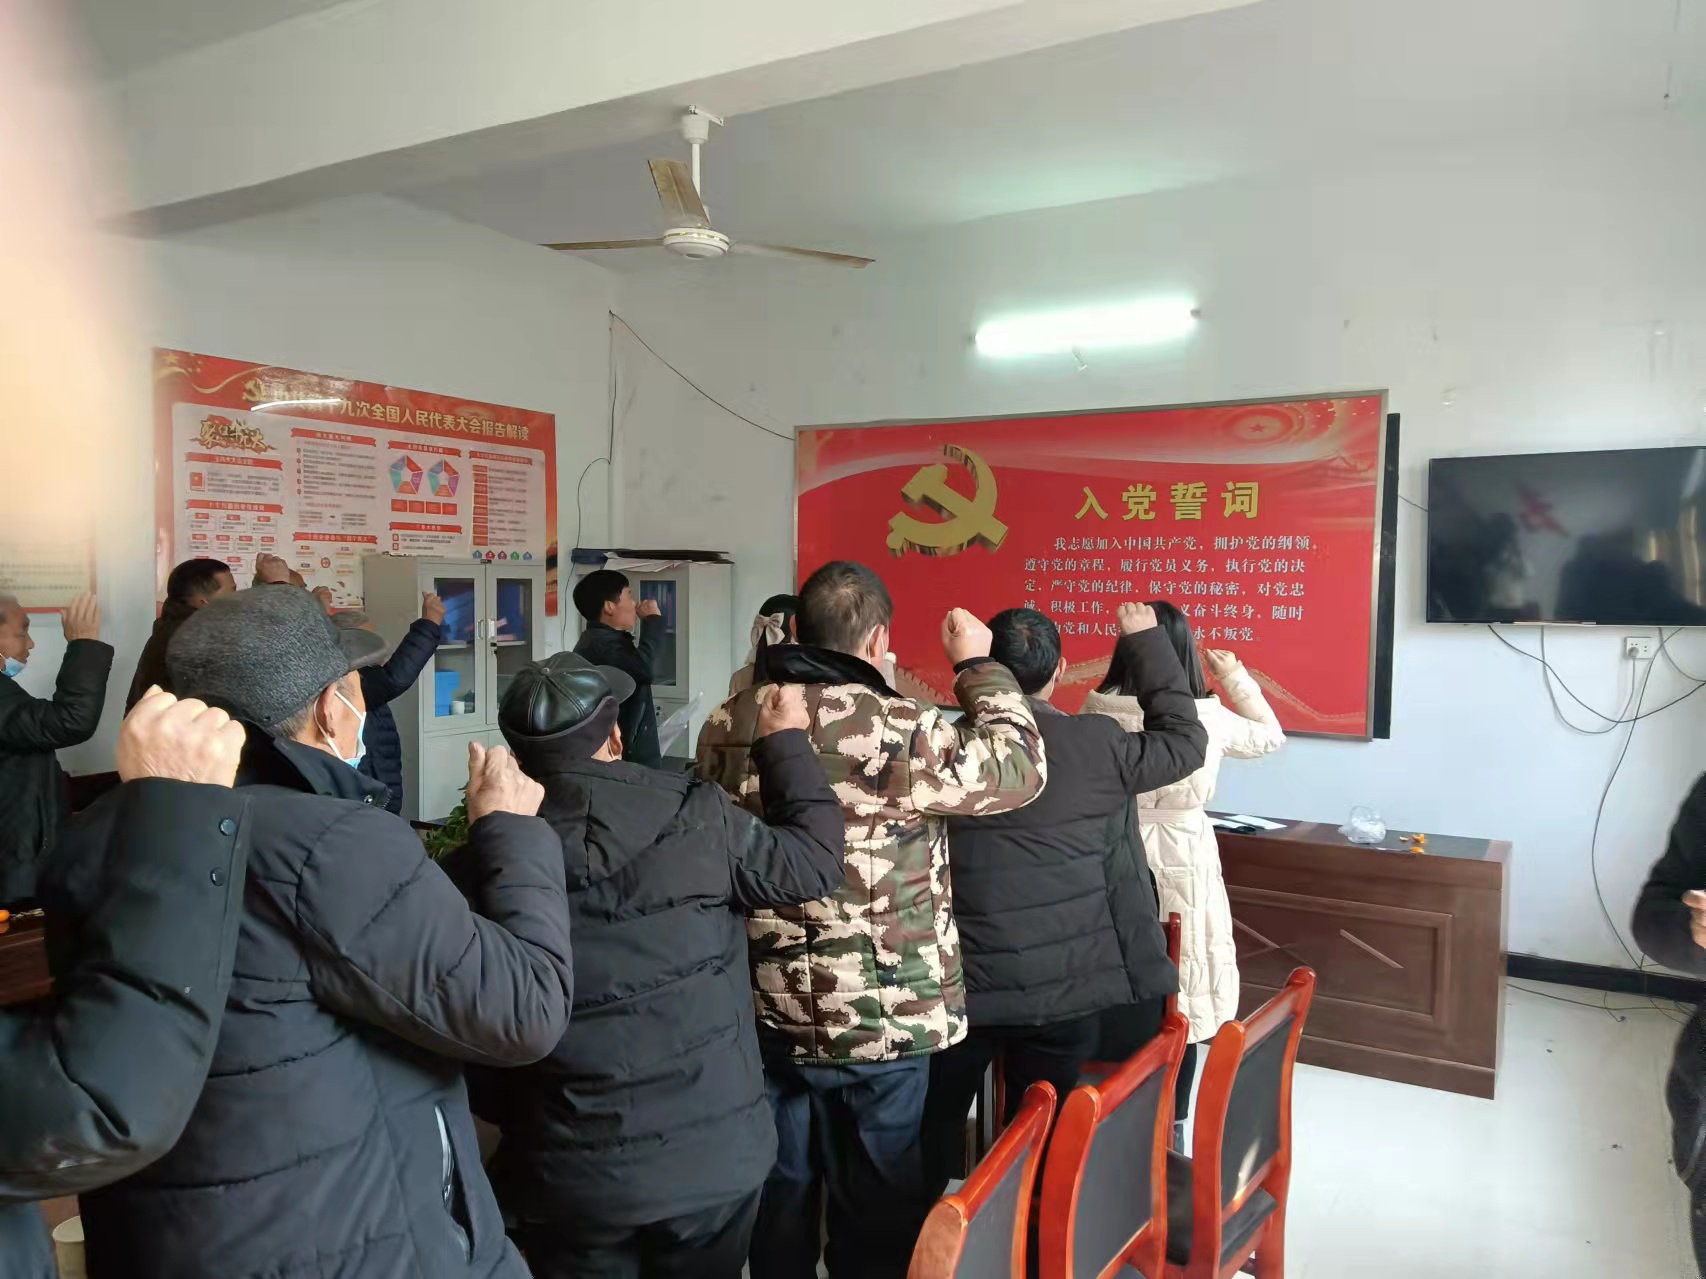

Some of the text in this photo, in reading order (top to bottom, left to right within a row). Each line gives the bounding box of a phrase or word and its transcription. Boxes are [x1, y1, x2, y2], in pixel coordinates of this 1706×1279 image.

[1075, 481, 1259, 520] 入党誓词
[1024, 557, 1306, 573] 遵守党的章程，履行党员义务，执行党的决
[1024, 578, 1306, 596] 定，严守党的纪律，保守党的秘密，对党忠
